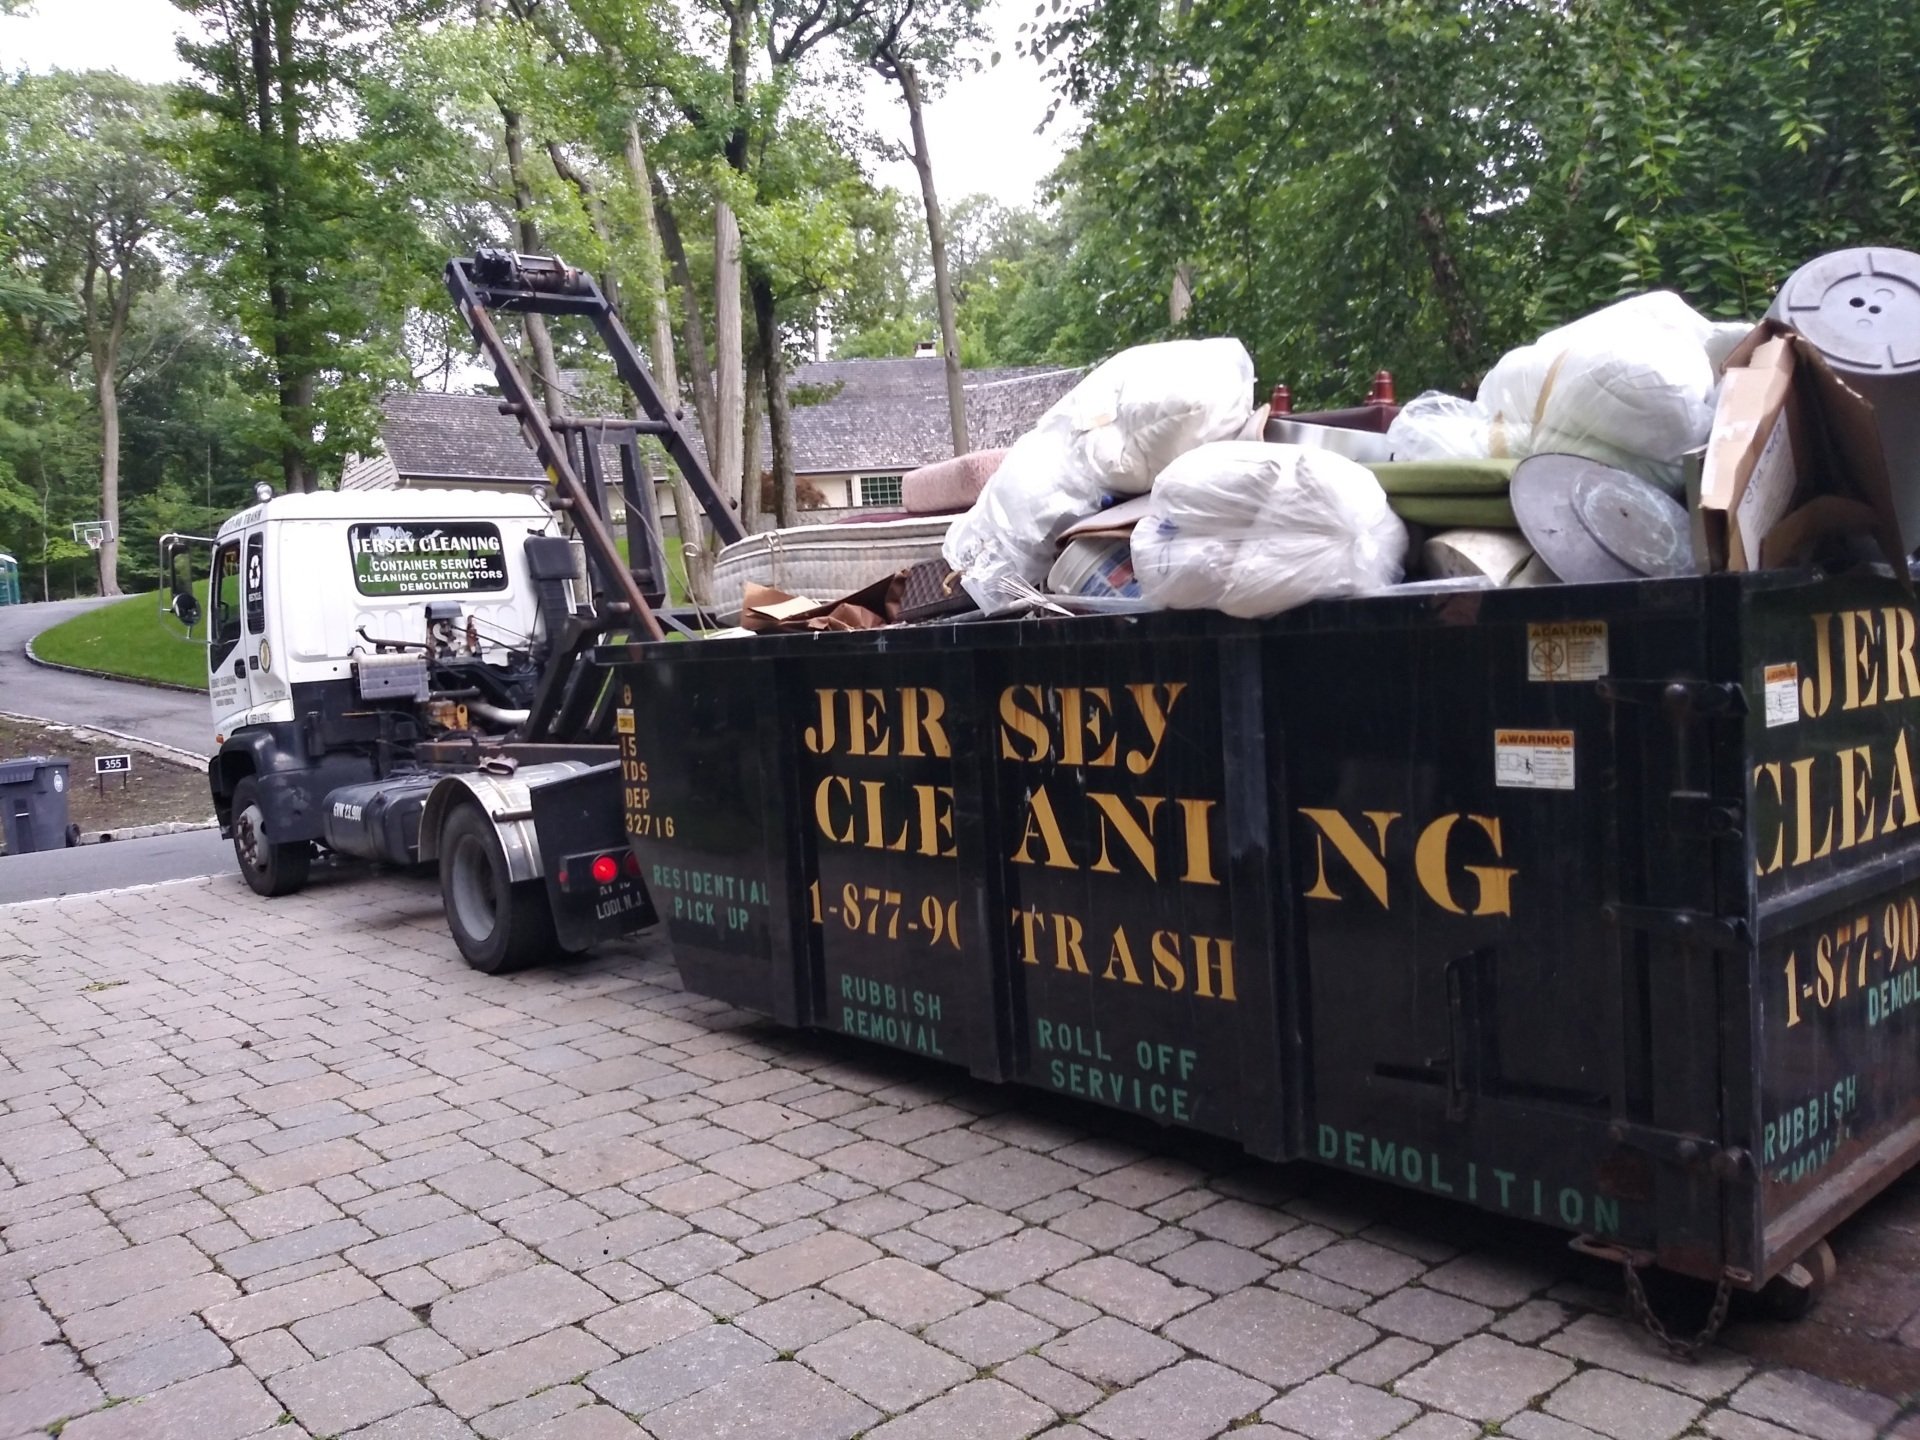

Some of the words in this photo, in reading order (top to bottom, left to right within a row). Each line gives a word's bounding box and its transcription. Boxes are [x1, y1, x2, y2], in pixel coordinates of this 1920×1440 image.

[419, 536, 501, 552] CLEANING
[358, 573, 418, 583] CLEANING
[421, 570, 503, 581] CONTRACTORS
[371, 559, 438, 571] CONTAINER
[440, 558, 488, 570] SERVICE
[400, 581, 469, 592] DEMOLITION
[622, 737, 637, 757] 15
[1508, 735, 1571, 746] WARNING
[104, 759, 122, 769] 355
[622, 760, 648, 782] YDS
[625, 788, 650, 808] DEP
[652, 864, 770, 906] RESIDENTIAL
[674, 896, 716, 926] PICK
[727, 906, 750, 932] UP
[1011, 906, 1238, 1002] TRASH
[841, 973, 942, 1022] RUBBISH
[1868, 966, 1920, 1026] DEMOL
[842, 1006, 944, 1056] REMOVAL
[1038, 1017, 1112, 1062] ROLL
[1136, 1040, 1197, 1082] OFF
[1050, 1060, 1191, 1122] SERVICE
[1764, 1073, 1856, 1165] RUBBISH
[1318, 1124, 1621, 1235] DEMOLITION
